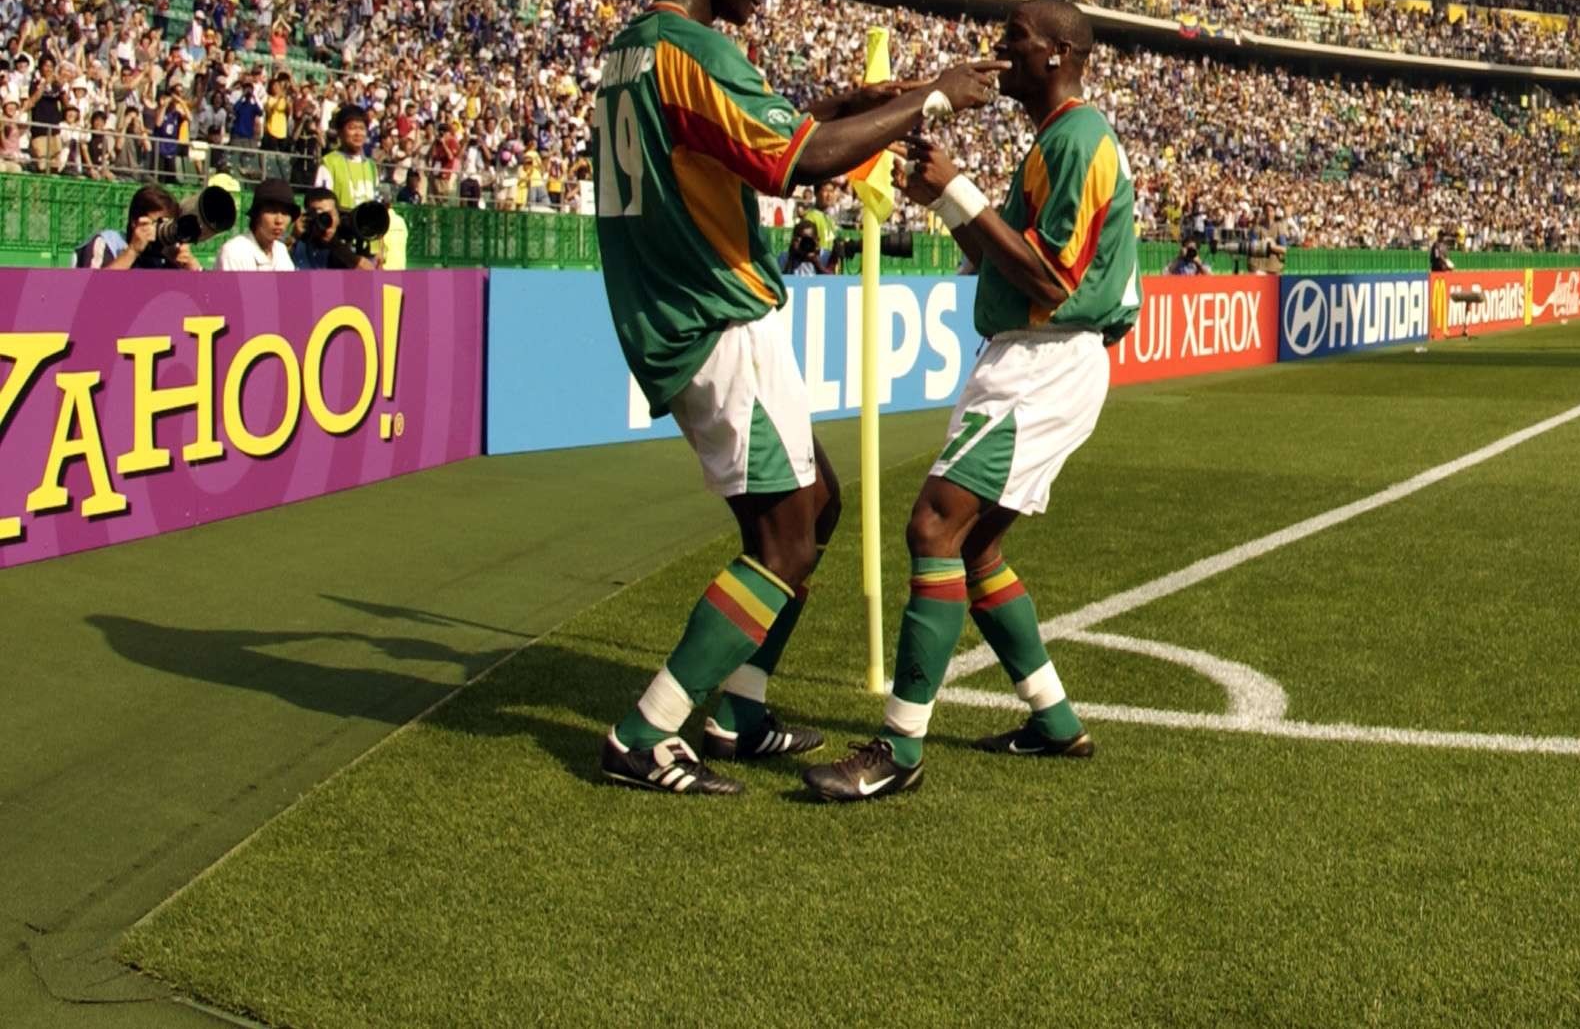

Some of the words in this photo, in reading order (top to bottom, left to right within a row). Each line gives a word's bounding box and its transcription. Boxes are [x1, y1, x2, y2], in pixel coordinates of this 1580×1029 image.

[593, 89, 644, 217] 19
[1180, 290, 1262, 359] XEROX
[1328, 279, 1429, 348] HYUNDAI
[940, 413, 990, 462] 7
